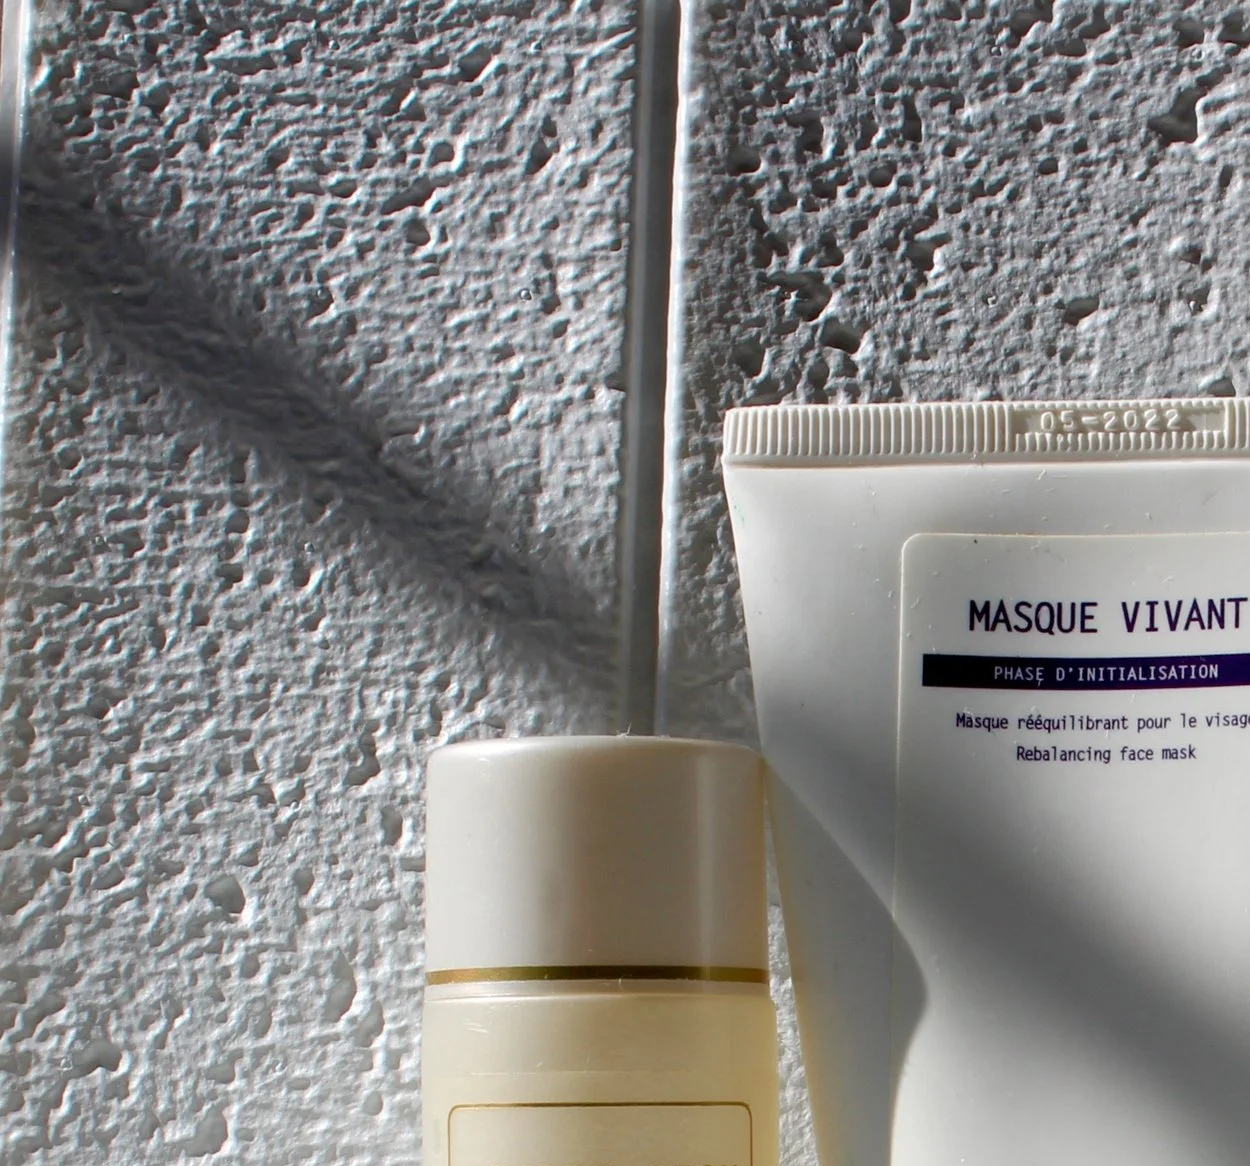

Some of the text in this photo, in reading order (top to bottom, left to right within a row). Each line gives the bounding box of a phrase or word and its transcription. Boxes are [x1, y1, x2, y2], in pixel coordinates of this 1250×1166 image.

[969, 597, 1248, 635] MASQUE VIVANT
[995, 663, 1219, 682] PHASE D'INITIALISATION
[956, 713, 1008, 732] Masque
[1018, 714, 1128, 733] rééquilibrant
[1137, 717, 1171, 733] pour
[1181, 713, 1197, 728] le
[1017, 744, 1196, 764] Rebalancing face mask
